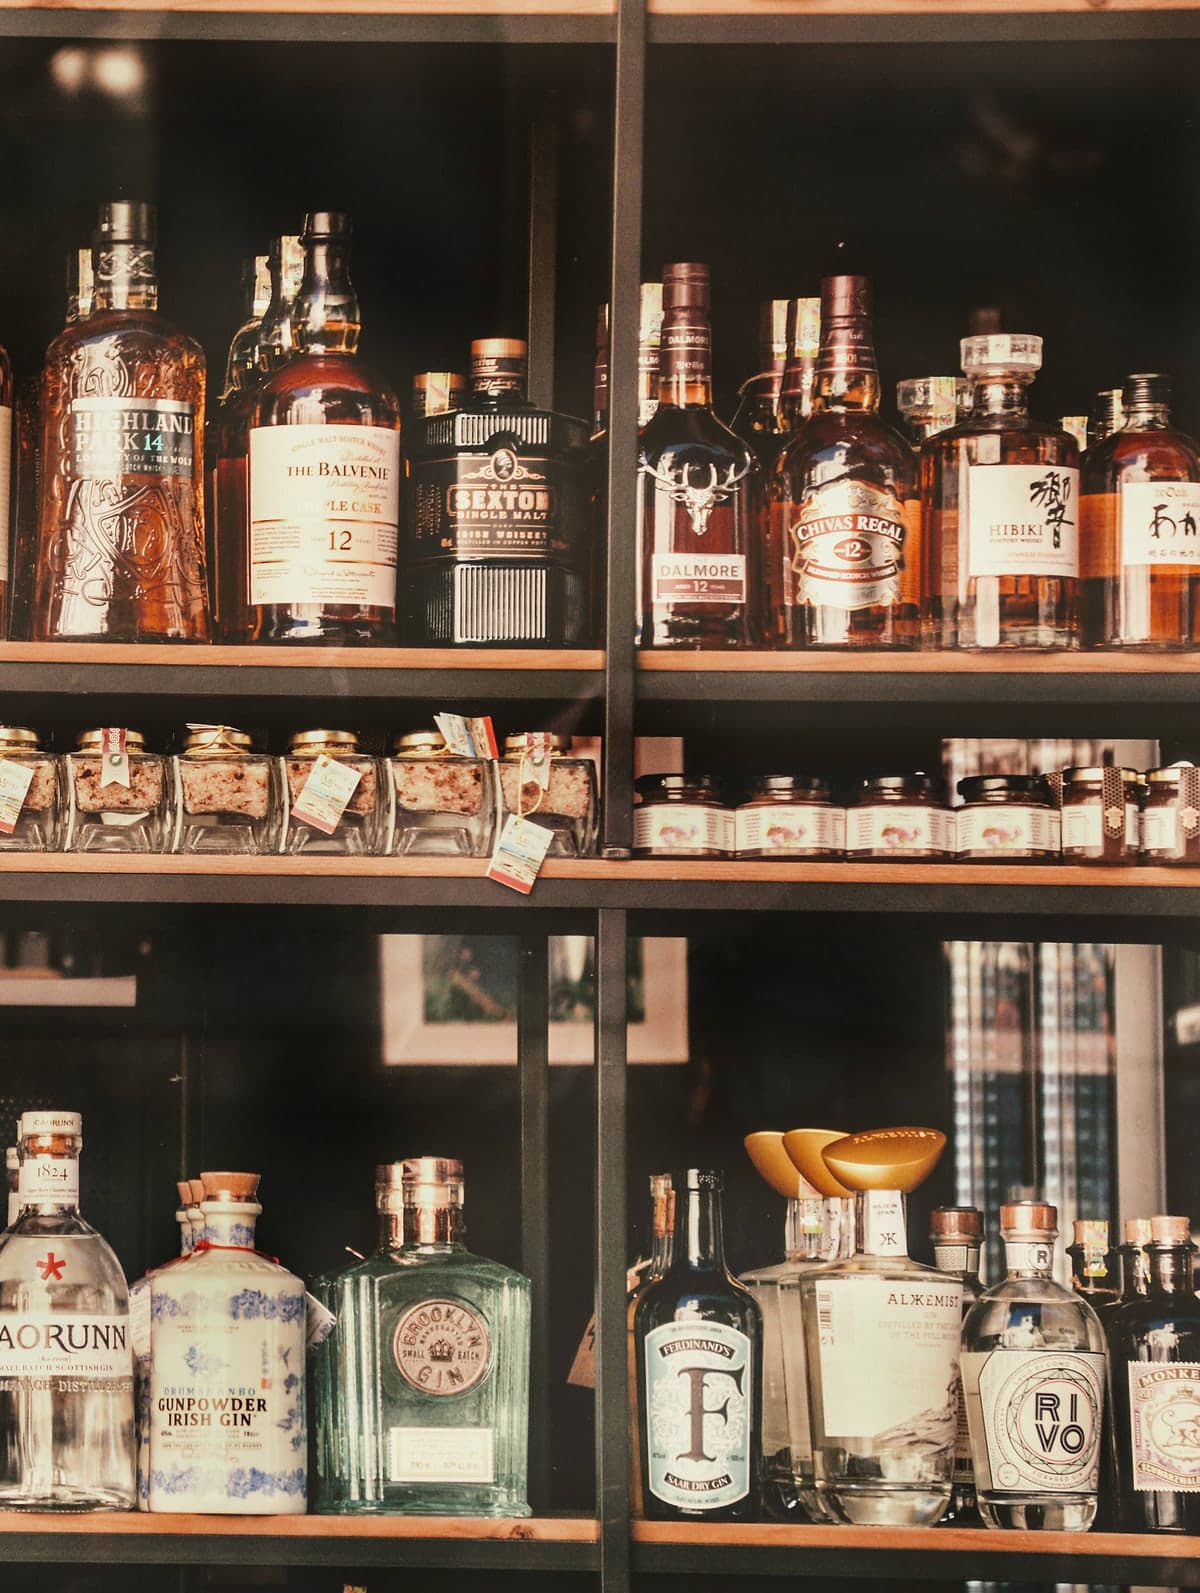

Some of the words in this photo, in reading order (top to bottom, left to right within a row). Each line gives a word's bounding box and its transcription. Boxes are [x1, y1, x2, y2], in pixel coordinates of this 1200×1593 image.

[143, 433, 165, 451] 14
[287, 465, 313, 477] THE
[318, 462, 389, 481] BALVENIE
[351, 501, 383, 514] CASK
[455, 490, 549, 511] SEXTON
[457, 511, 508, 520] SINGLE
[513, 511, 548, 520] MALT
[797, 515, 853, 542] CHIVAS
[857, 515, 904, 542] REGAL
[989, 524, 1044, 536] HIBIKI
[328, 530, 353, 551] 12
[845, 541, 861, 558] 12
[660, 564, 740, 578] DALMORE
[692, 580, 709, 593] 12
[37, 1163, 69, 1181] 1824
[1037, 1249, 1049, 1264] R
[400, 1306, 482, 1350] BROOKLYN
[402, 1350, 426, 1360] SMALL
[457, 1350, 481, 1361] BATCH
[662, 1340, 731, 1358] FERDINAND'S
[417, 1364, 465, 1388] GIN
[1141, 1369, 1200, 1388] MONKE
[158, 1397, 268, 1412] GUNPOWDER
[168, 1413, 213, 1427] IRISH
[219, 1413, 252, 1427] GIN
[675, 1364, 746, 1463] F
[691, 1479, 711, 1491] DRY
[710, 1475, 729, 1489] GIN
